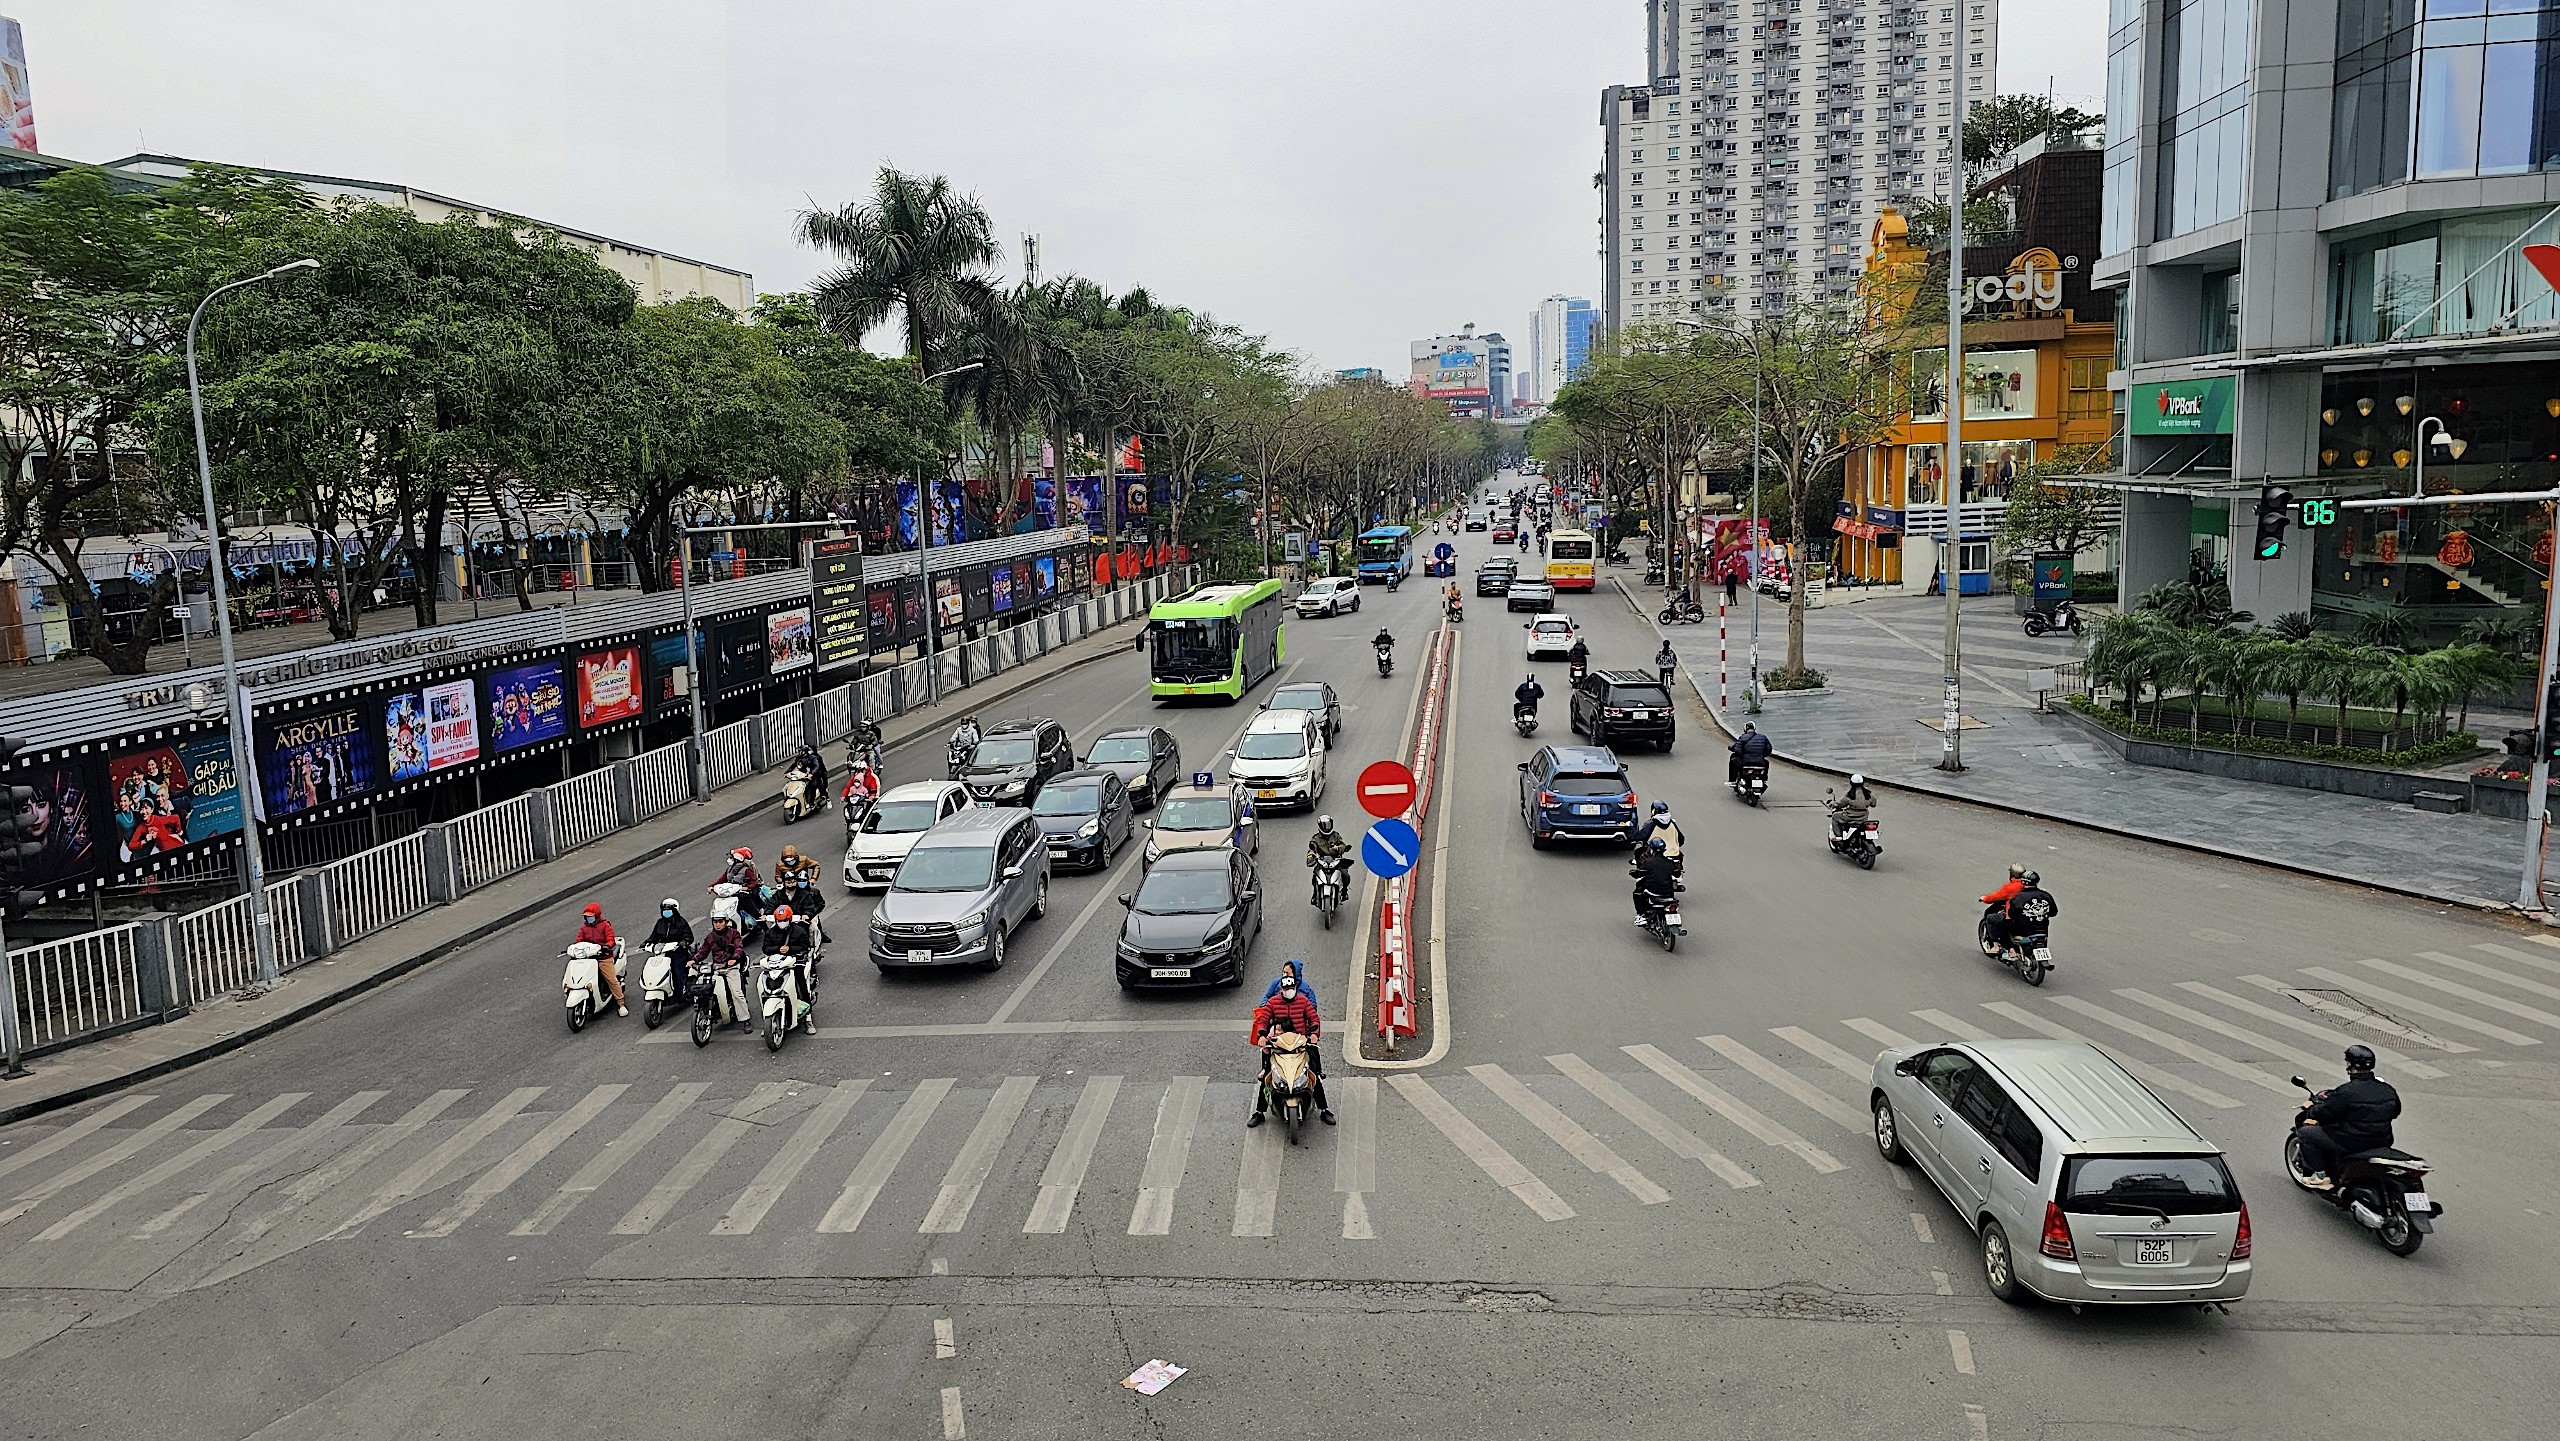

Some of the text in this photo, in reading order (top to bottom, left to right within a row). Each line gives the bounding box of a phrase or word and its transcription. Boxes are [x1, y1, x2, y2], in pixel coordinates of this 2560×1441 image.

[1458, 371, 1476, 379] Shop
[2169, 395, 2202, 414] VPBank
[2304, 500, 2335, 525] 06
[275, 712, 359, 750] ARGYLLE
[195, 759, 230, 781] GẶP LẠI
[193, 784, 206, 796] CHỊ
[2145, 1240, 2165, 1250] 52P
[2141, 1251, 2168, 1261] 6005
